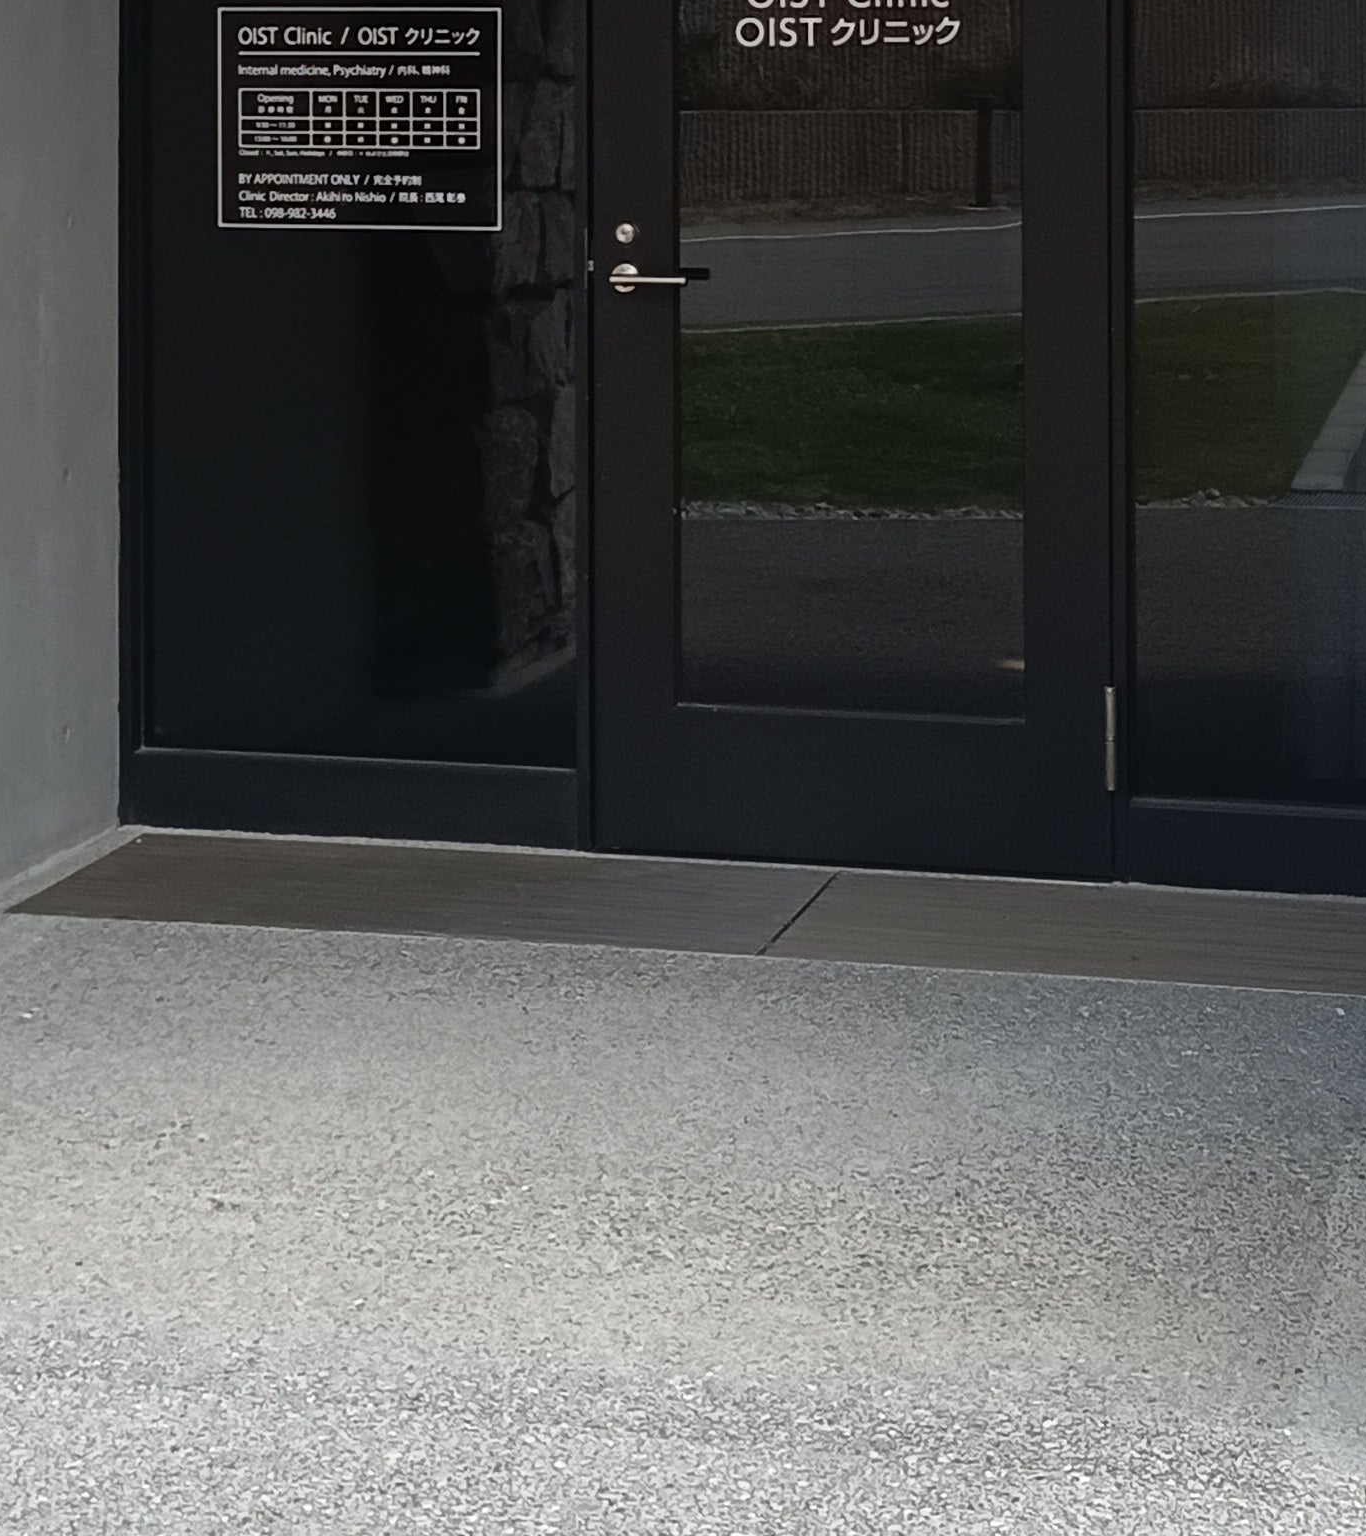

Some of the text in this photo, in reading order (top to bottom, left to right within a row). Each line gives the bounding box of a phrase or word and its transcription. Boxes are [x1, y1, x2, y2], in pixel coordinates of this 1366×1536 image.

[238, 27, 480, 45] OIST Clinic / OIST クリニック
[736, 17, 960, 47] OIST クリニック
[238, 64, 278, 75] Internal
[280, 64, 331, 76] medicine,
[333, 64, 386, 78] Psychiatry
[239, 173, 252, 184] BY
[254, 173, 329, 185] APPOINTMENT
[331, 174, 360, 185] ONLY
[239, 190, 266, 201] Clinic
[355, 192, 386, 203] Nishio
